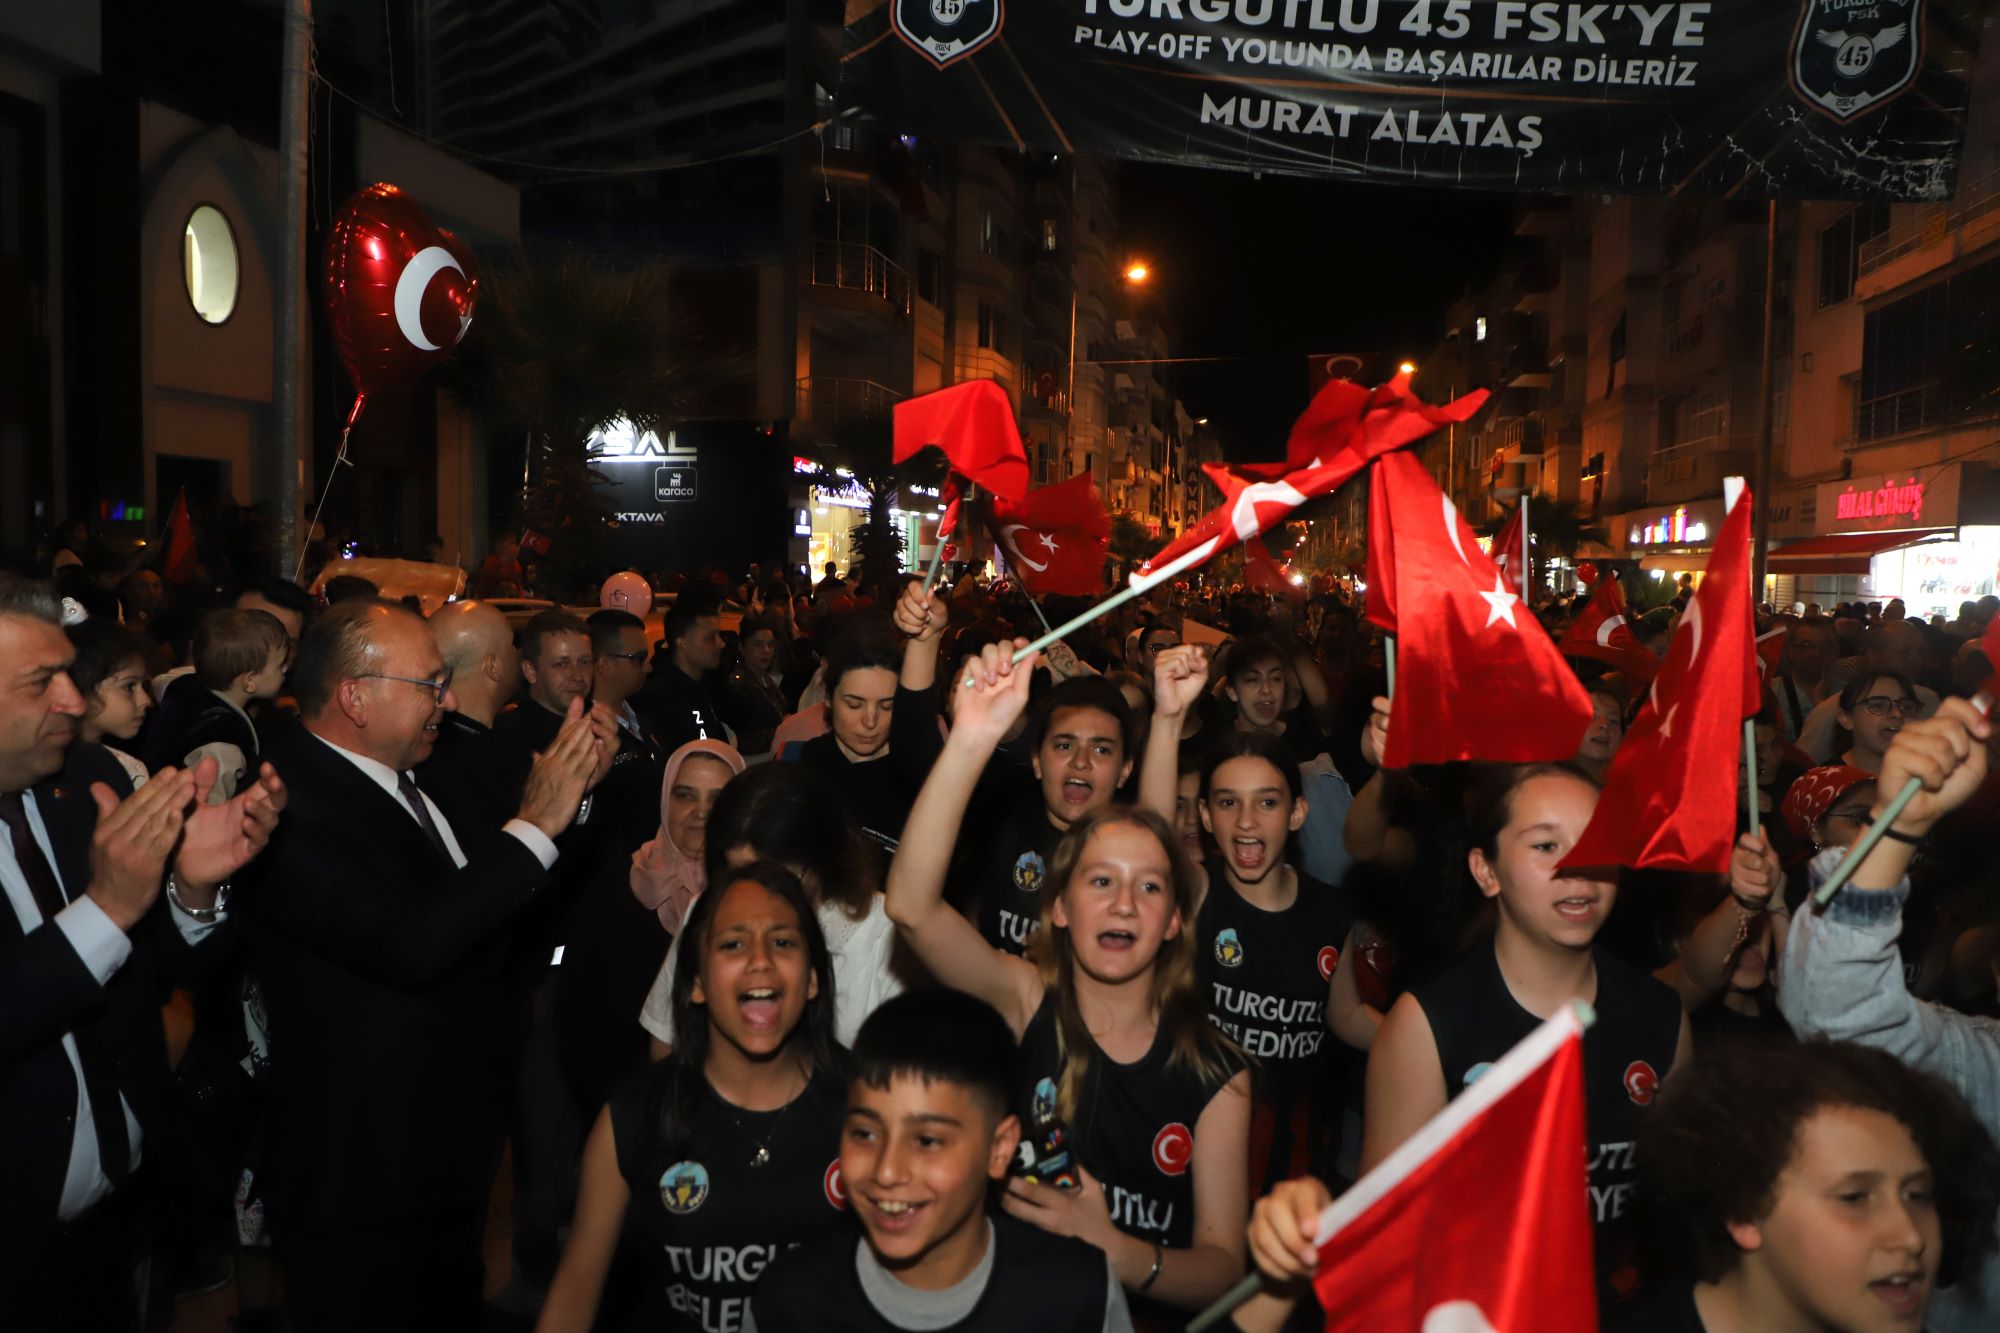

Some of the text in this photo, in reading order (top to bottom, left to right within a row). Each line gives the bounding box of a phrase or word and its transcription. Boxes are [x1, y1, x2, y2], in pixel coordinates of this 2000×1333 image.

[1399, 0, 1471, 39] 45
[1493, 1, 1711, 47] FSK'YE
[1847, 5, 1880, 22] FSK
[1221, 37, 1374, 71] YOLUNDA
[1384, 47, 1562, 82] BAŞARILAR
[1573, 53, 1698, 87] DİLERİZ
[1839, 46, 1870, 67] 45
[1200, 92, 1543, 158] MURAT ALATAŞ
